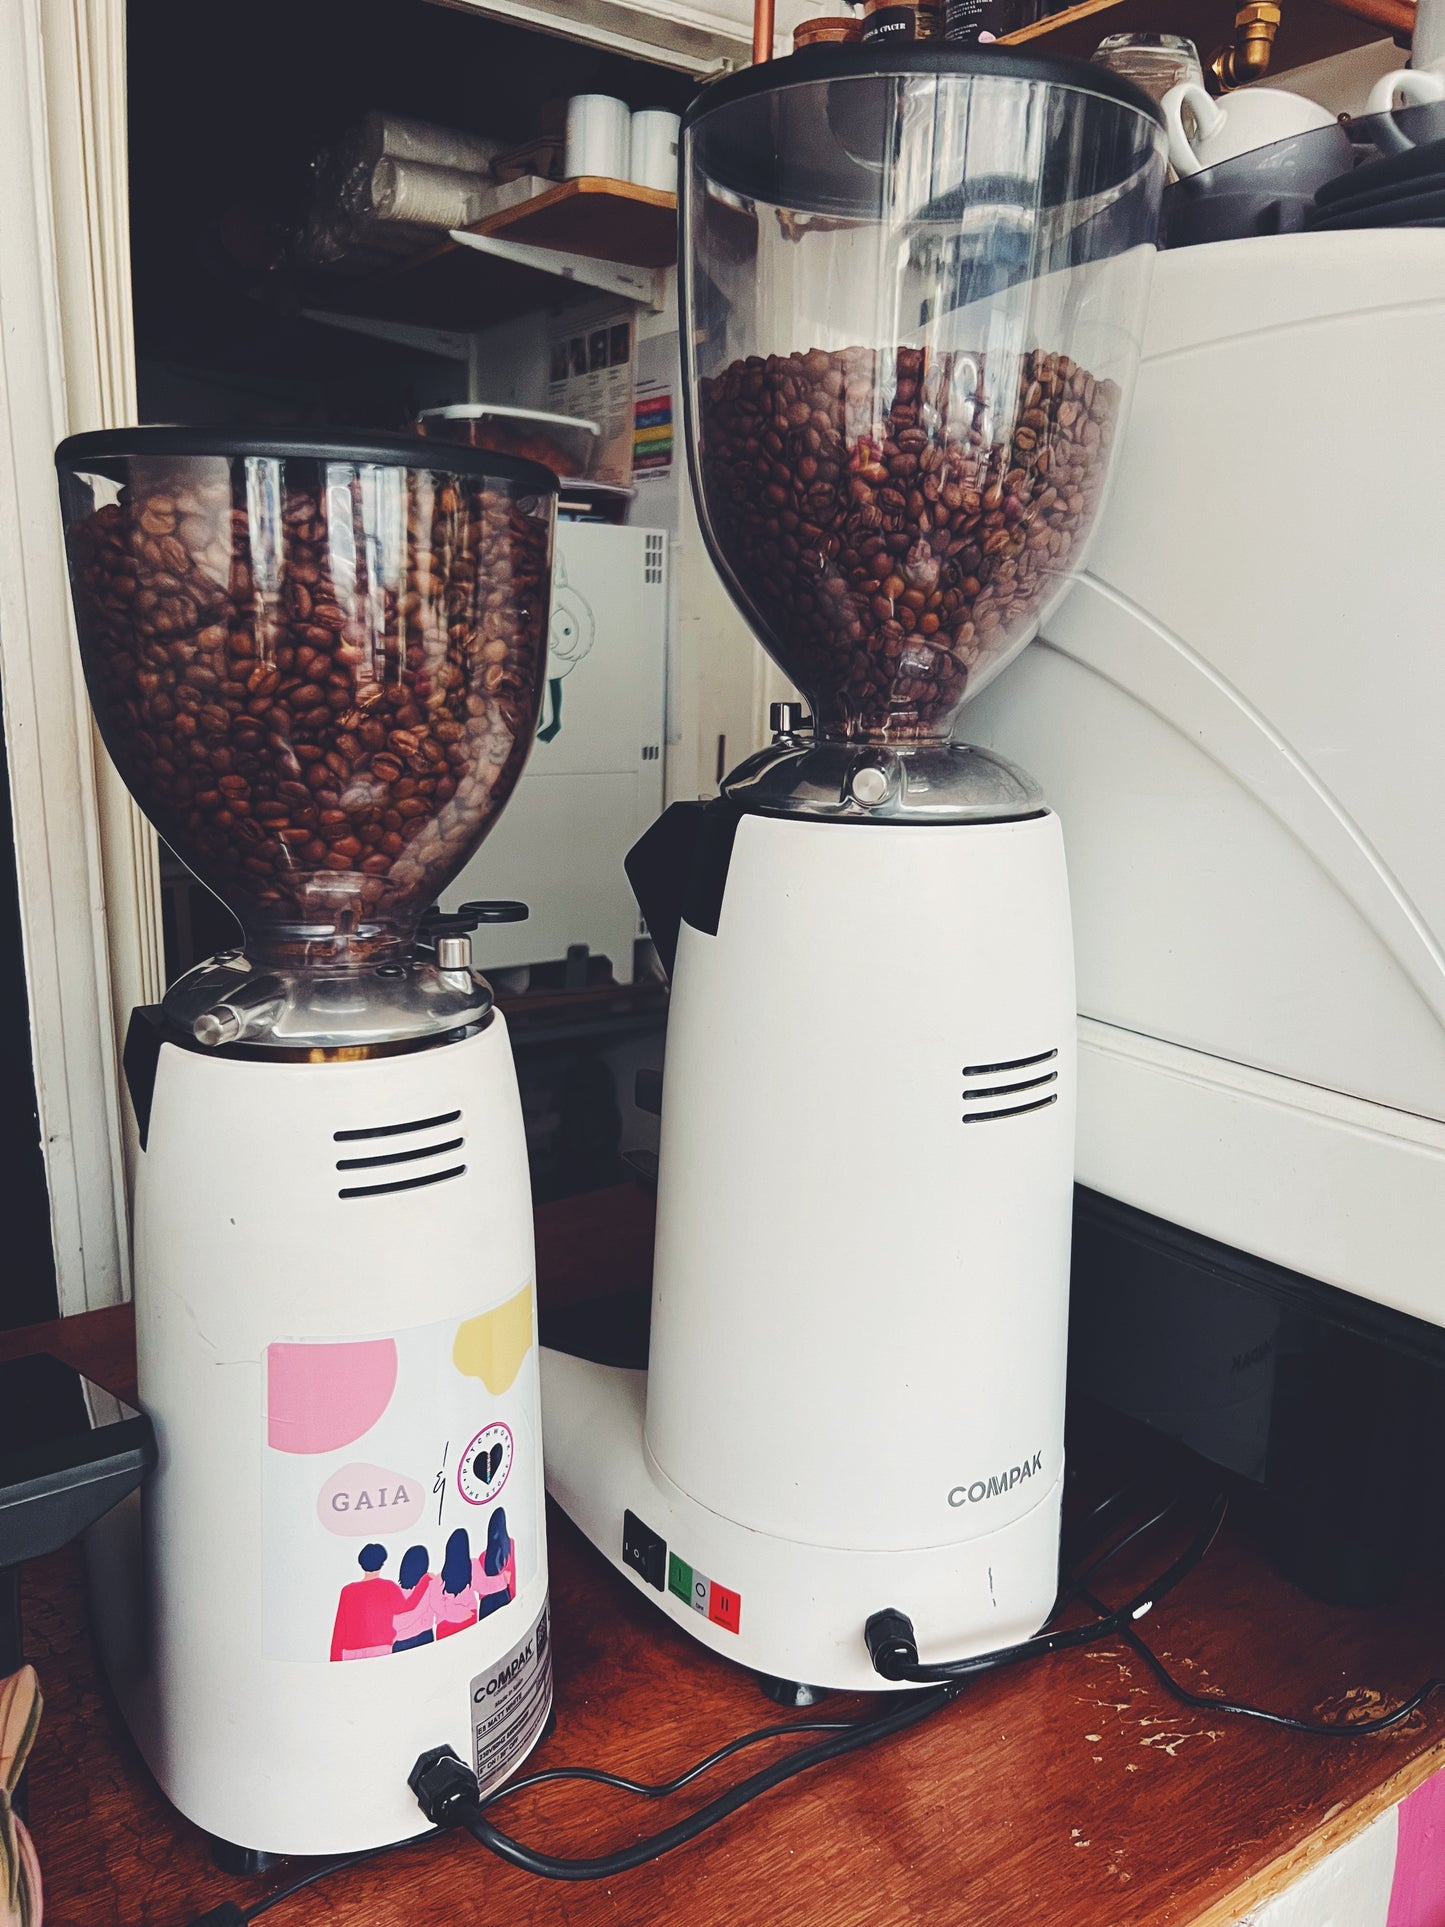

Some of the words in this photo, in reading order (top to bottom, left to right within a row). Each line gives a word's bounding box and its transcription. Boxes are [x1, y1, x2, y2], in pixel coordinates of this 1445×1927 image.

[463, 1428, 511, 1474] PATCHWORK
[331, 1485, 411, 1512] GAIA
[947, 1449, 1042, 1508] COMPAK
[473, 1637, 533, 1704] COMPAK
[487, 1709, 505, 1729] MATT
[505, 1692, 522, 1711] WHITE
